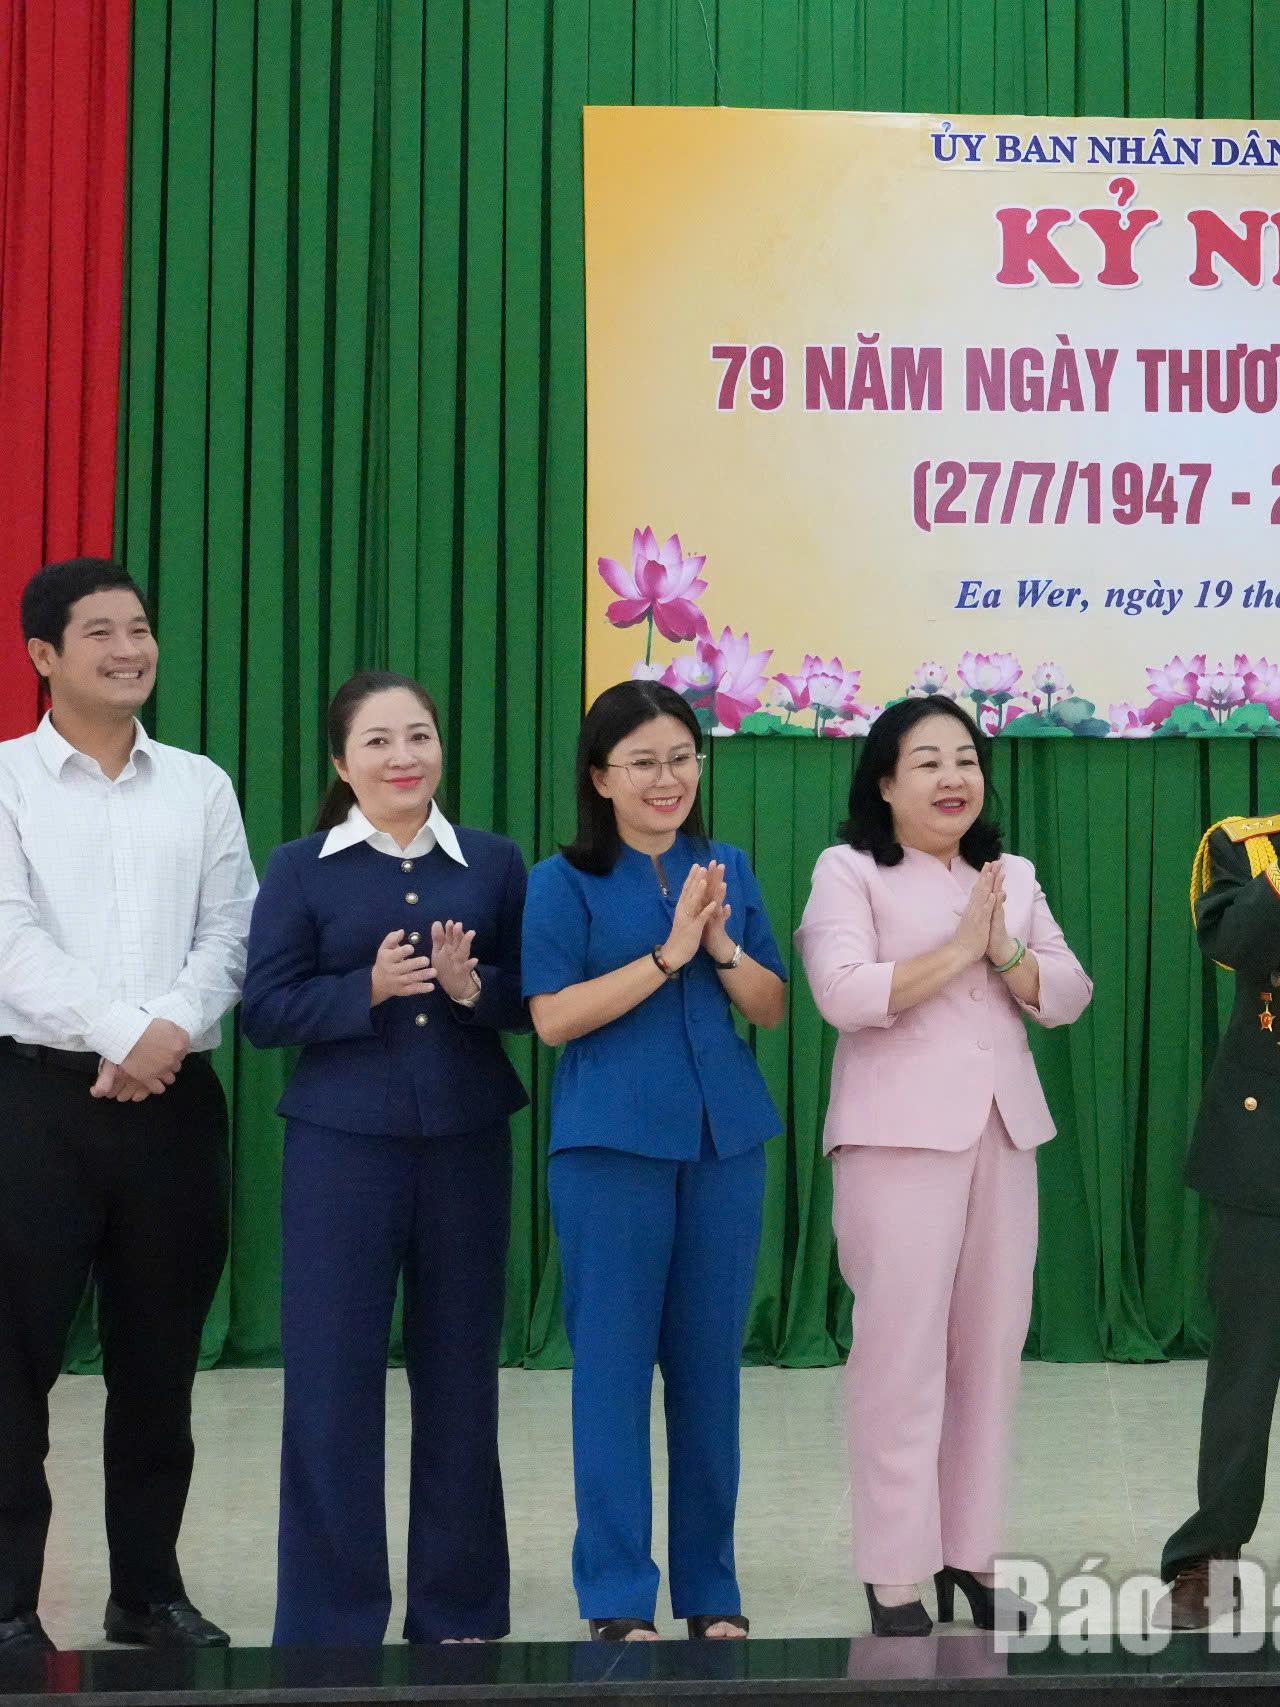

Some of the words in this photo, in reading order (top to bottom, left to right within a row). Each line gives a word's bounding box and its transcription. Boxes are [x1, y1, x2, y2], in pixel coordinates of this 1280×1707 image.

[932, 122, 984, 164] ỦY
[996, 135, 1077, 165] BAN
[1088, 128, 1202, 167] NHÂN
[996, 177, 1160, 286] KỶ
[712, 346, 784, 410] 79
[805, 332, 942, 411] NĂM
[966, 334, 1120, 412] NGÀY
[913, 460, 1212, 532] (27/7/1947
[1232, 491, 1250, 505] -
[955, 580, 1002, 609] Ea
[1016, 580, 1090, 612] Wer,
[1104, 579, 1183, 615] ngày
[1196, 579, 1232, 609] 19
